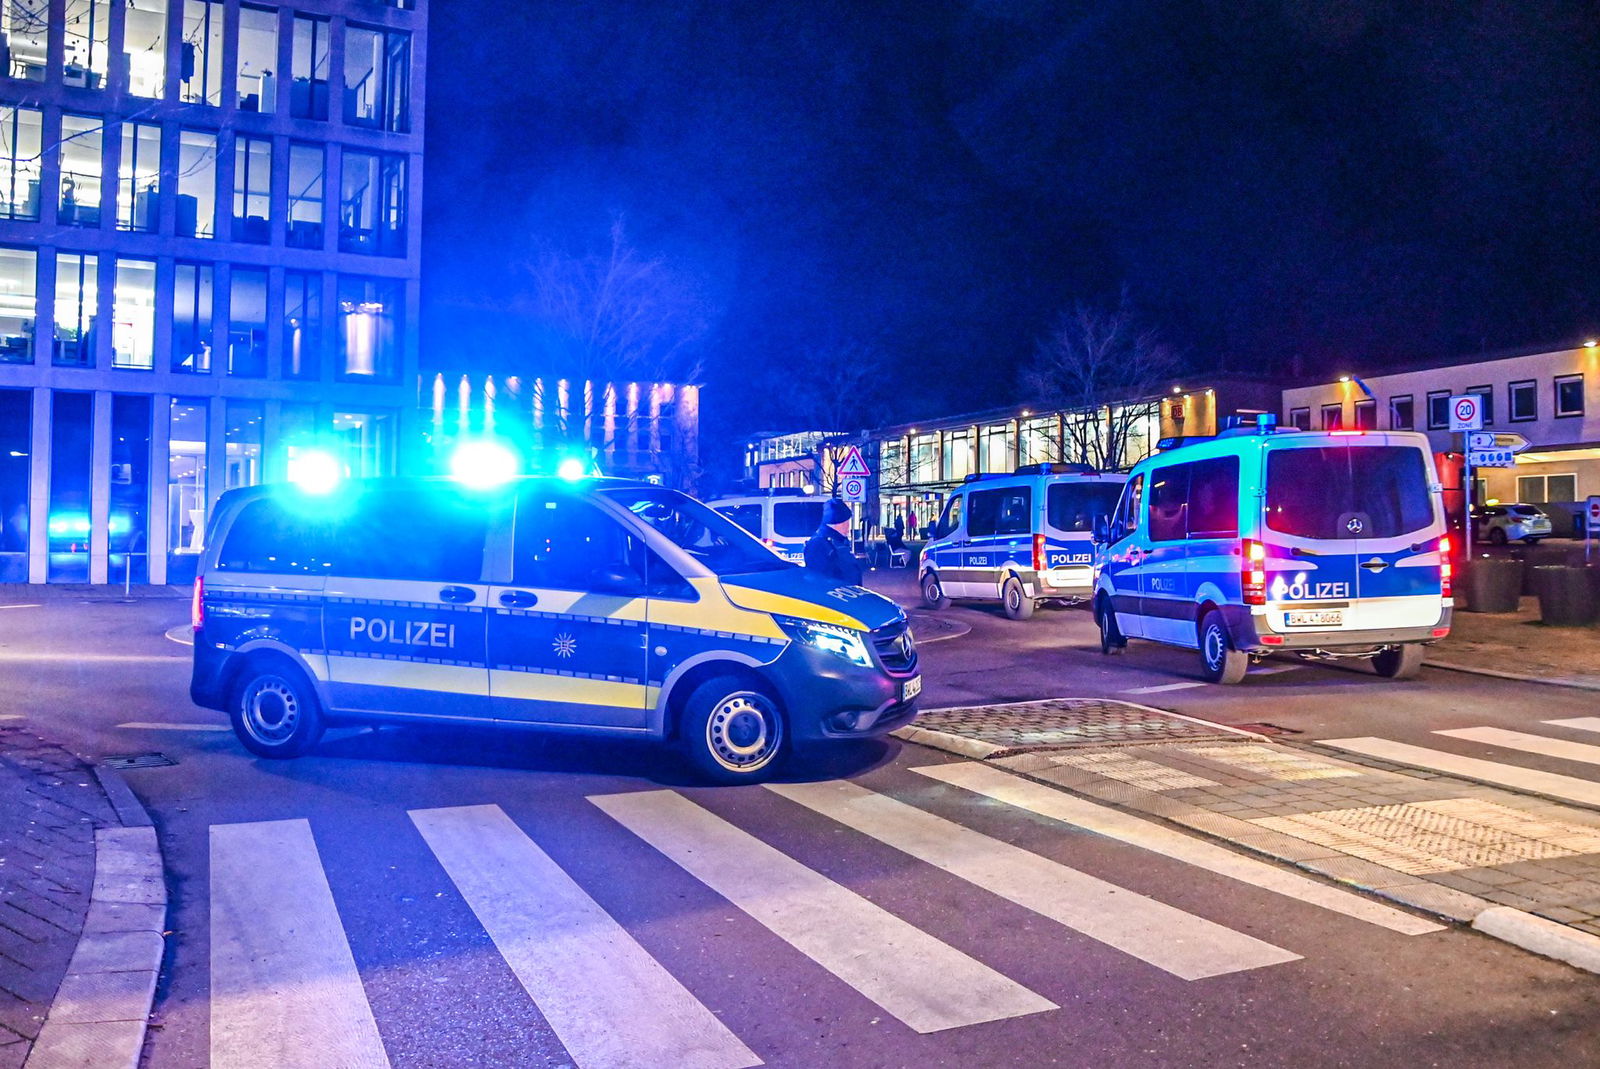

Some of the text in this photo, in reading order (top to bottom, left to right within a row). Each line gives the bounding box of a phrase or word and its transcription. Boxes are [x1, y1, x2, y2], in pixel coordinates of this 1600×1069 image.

[1460, 405, 1471, 415] 20
[849, 484, 859, 492] 20
[969, 556, 987, 565] POLIZEI
[1051, 554, 1092, 564] POLIZEI
[1151, 577, 1176, 592] POLIZEI
[1277, 582, 1350, 600] POLIZEI
[350, 617, 455, 648] POLIZEI
